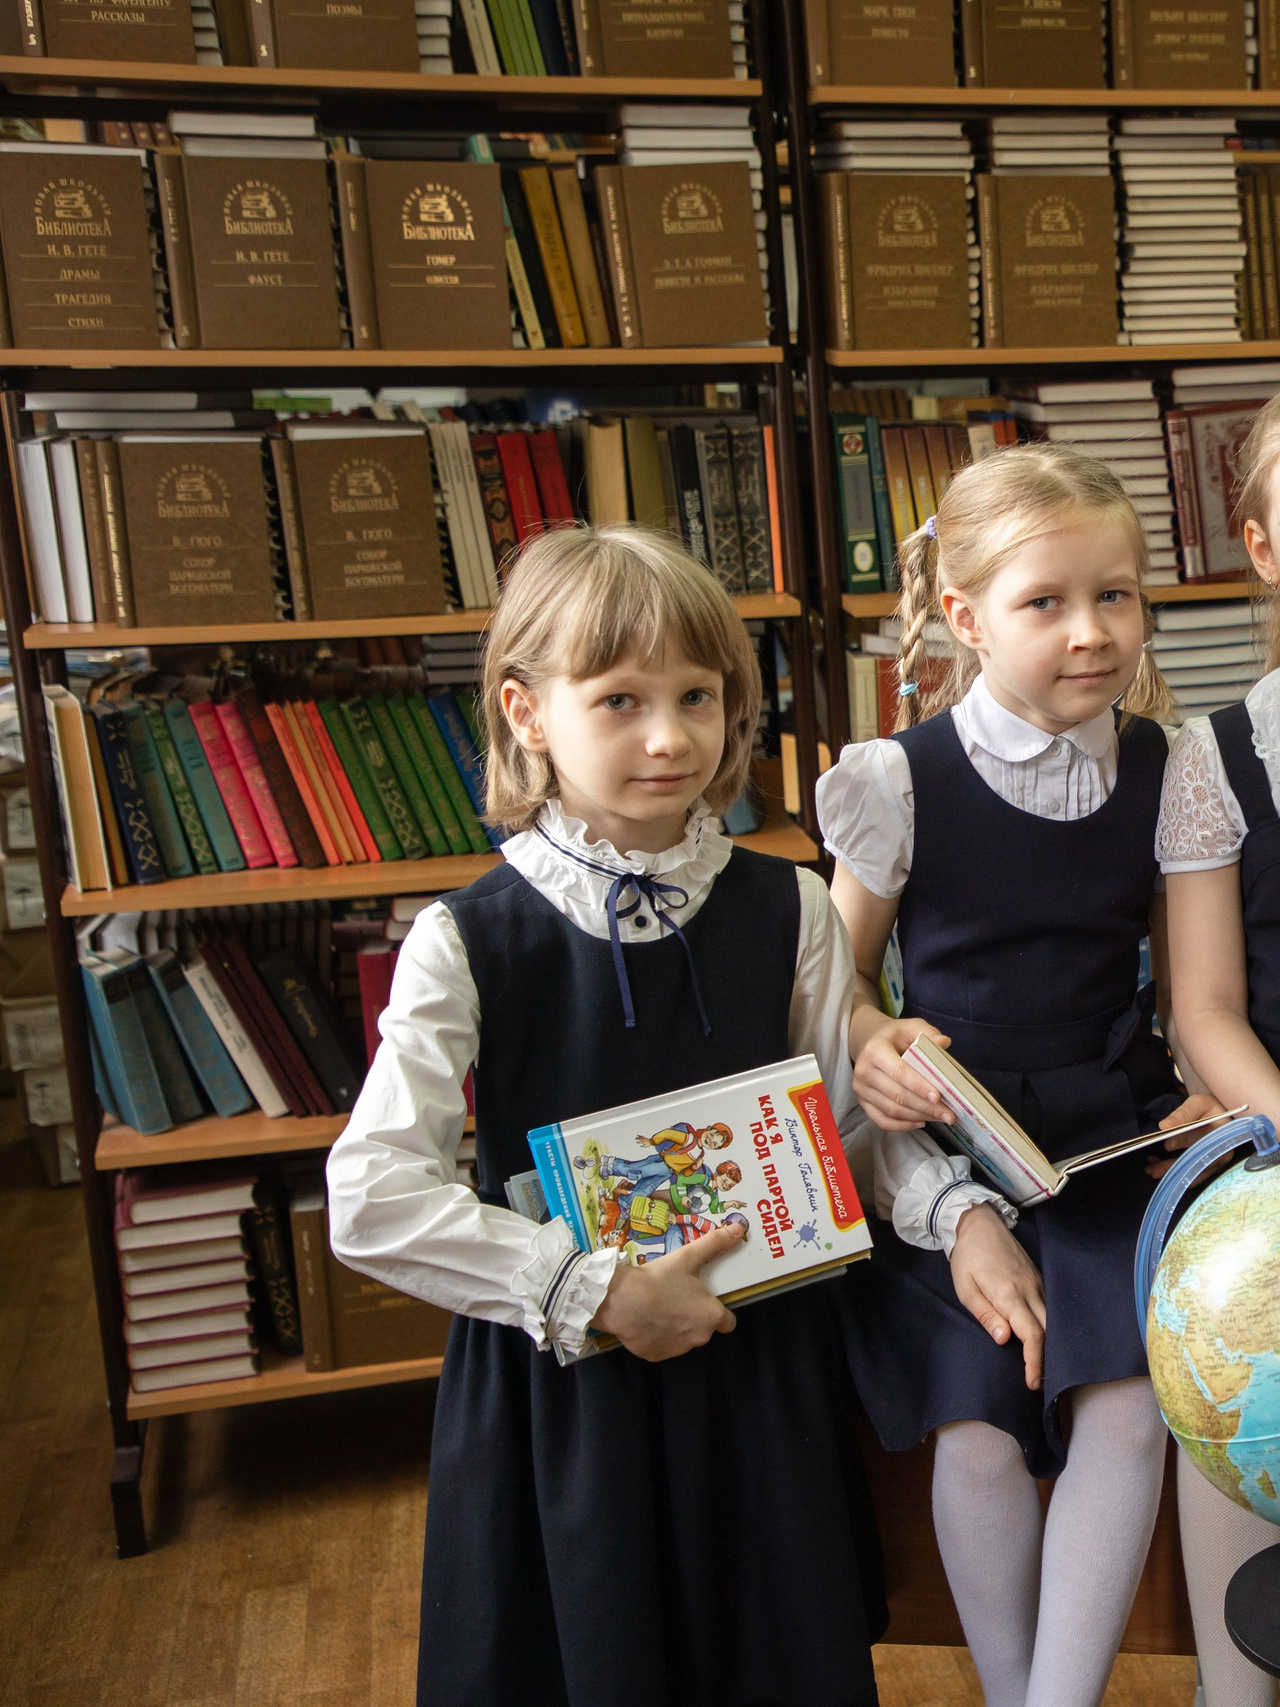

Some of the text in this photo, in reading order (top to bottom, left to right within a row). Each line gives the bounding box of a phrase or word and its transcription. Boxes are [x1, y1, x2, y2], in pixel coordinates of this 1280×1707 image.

[91, 10, 145, 23] РАССКАЗЫ
[326, 4, 362, 16] ПОЭМЫ
[863, 6, 889, 18] МАРК
[34, 178, 112, 216] НОВАЯ ШКОЛЬНАЯ
[35, 216, 112, 236] БИБЛИОТЕКА
[224, 216, 294, 236] БИБЛИОТЕКА
[402, 221, 475, 240] БИБЛИОТЕКА
[662, 218, 724, 235] БИБЛИОТЕКА
[47, 244, 107, 257] И. В. ГЕТЕ
[250, 251, 261, 262] В.
[263, 251, 290, 262] ГЕТЕ
[425, 255, 456, 266] ГОМЕР
[694, 256, 732, 267] ГОФМАН
[60, 269, 100, 280] ДРАМЫ
[248, 274, 283, 285] ФАУСТ
[54, 294, 112, 305] ТРАГЕДИЯ
[68, 318, 104, 328] СТИХИ
[157, 500, 230, 518] БИБЛИОТЕКА
[330, 494, 400, 514] БИБЛИОТЕКА
[172, 535, 222, 547] В. ГЮГО
[346, 528, 393, 541] В. ГЮГО
[356, 549, 388, 561] СОБОР
[182, 558, 215, 568] СОБОР
[344, 561, 403, 574] ПАРИЖСКОЙ
[169, 568, 231, 581] ПАРИЖСКОЙ
[345, 574, 405, 588] БОГОМАТЕРИ
[170, 583, 233, 594] БОГОМАТЕРИ
[757, 1094, 784, 1145] КАК Я
[804, 1096, 848, 1219] Школьная библиотека
[784, 1118, 819, 1212] Виктор Голявкин
[545, 1141, 556, 1167] ТЕКСТЫ
[553, 1169, 571, 1218] ПРОИЗВЕДЕНИЙ
[749, 1121, 795, 1232] ПОД ПАРТОЙ
[756, 1198, 785, 1259] СИДЕЛ
